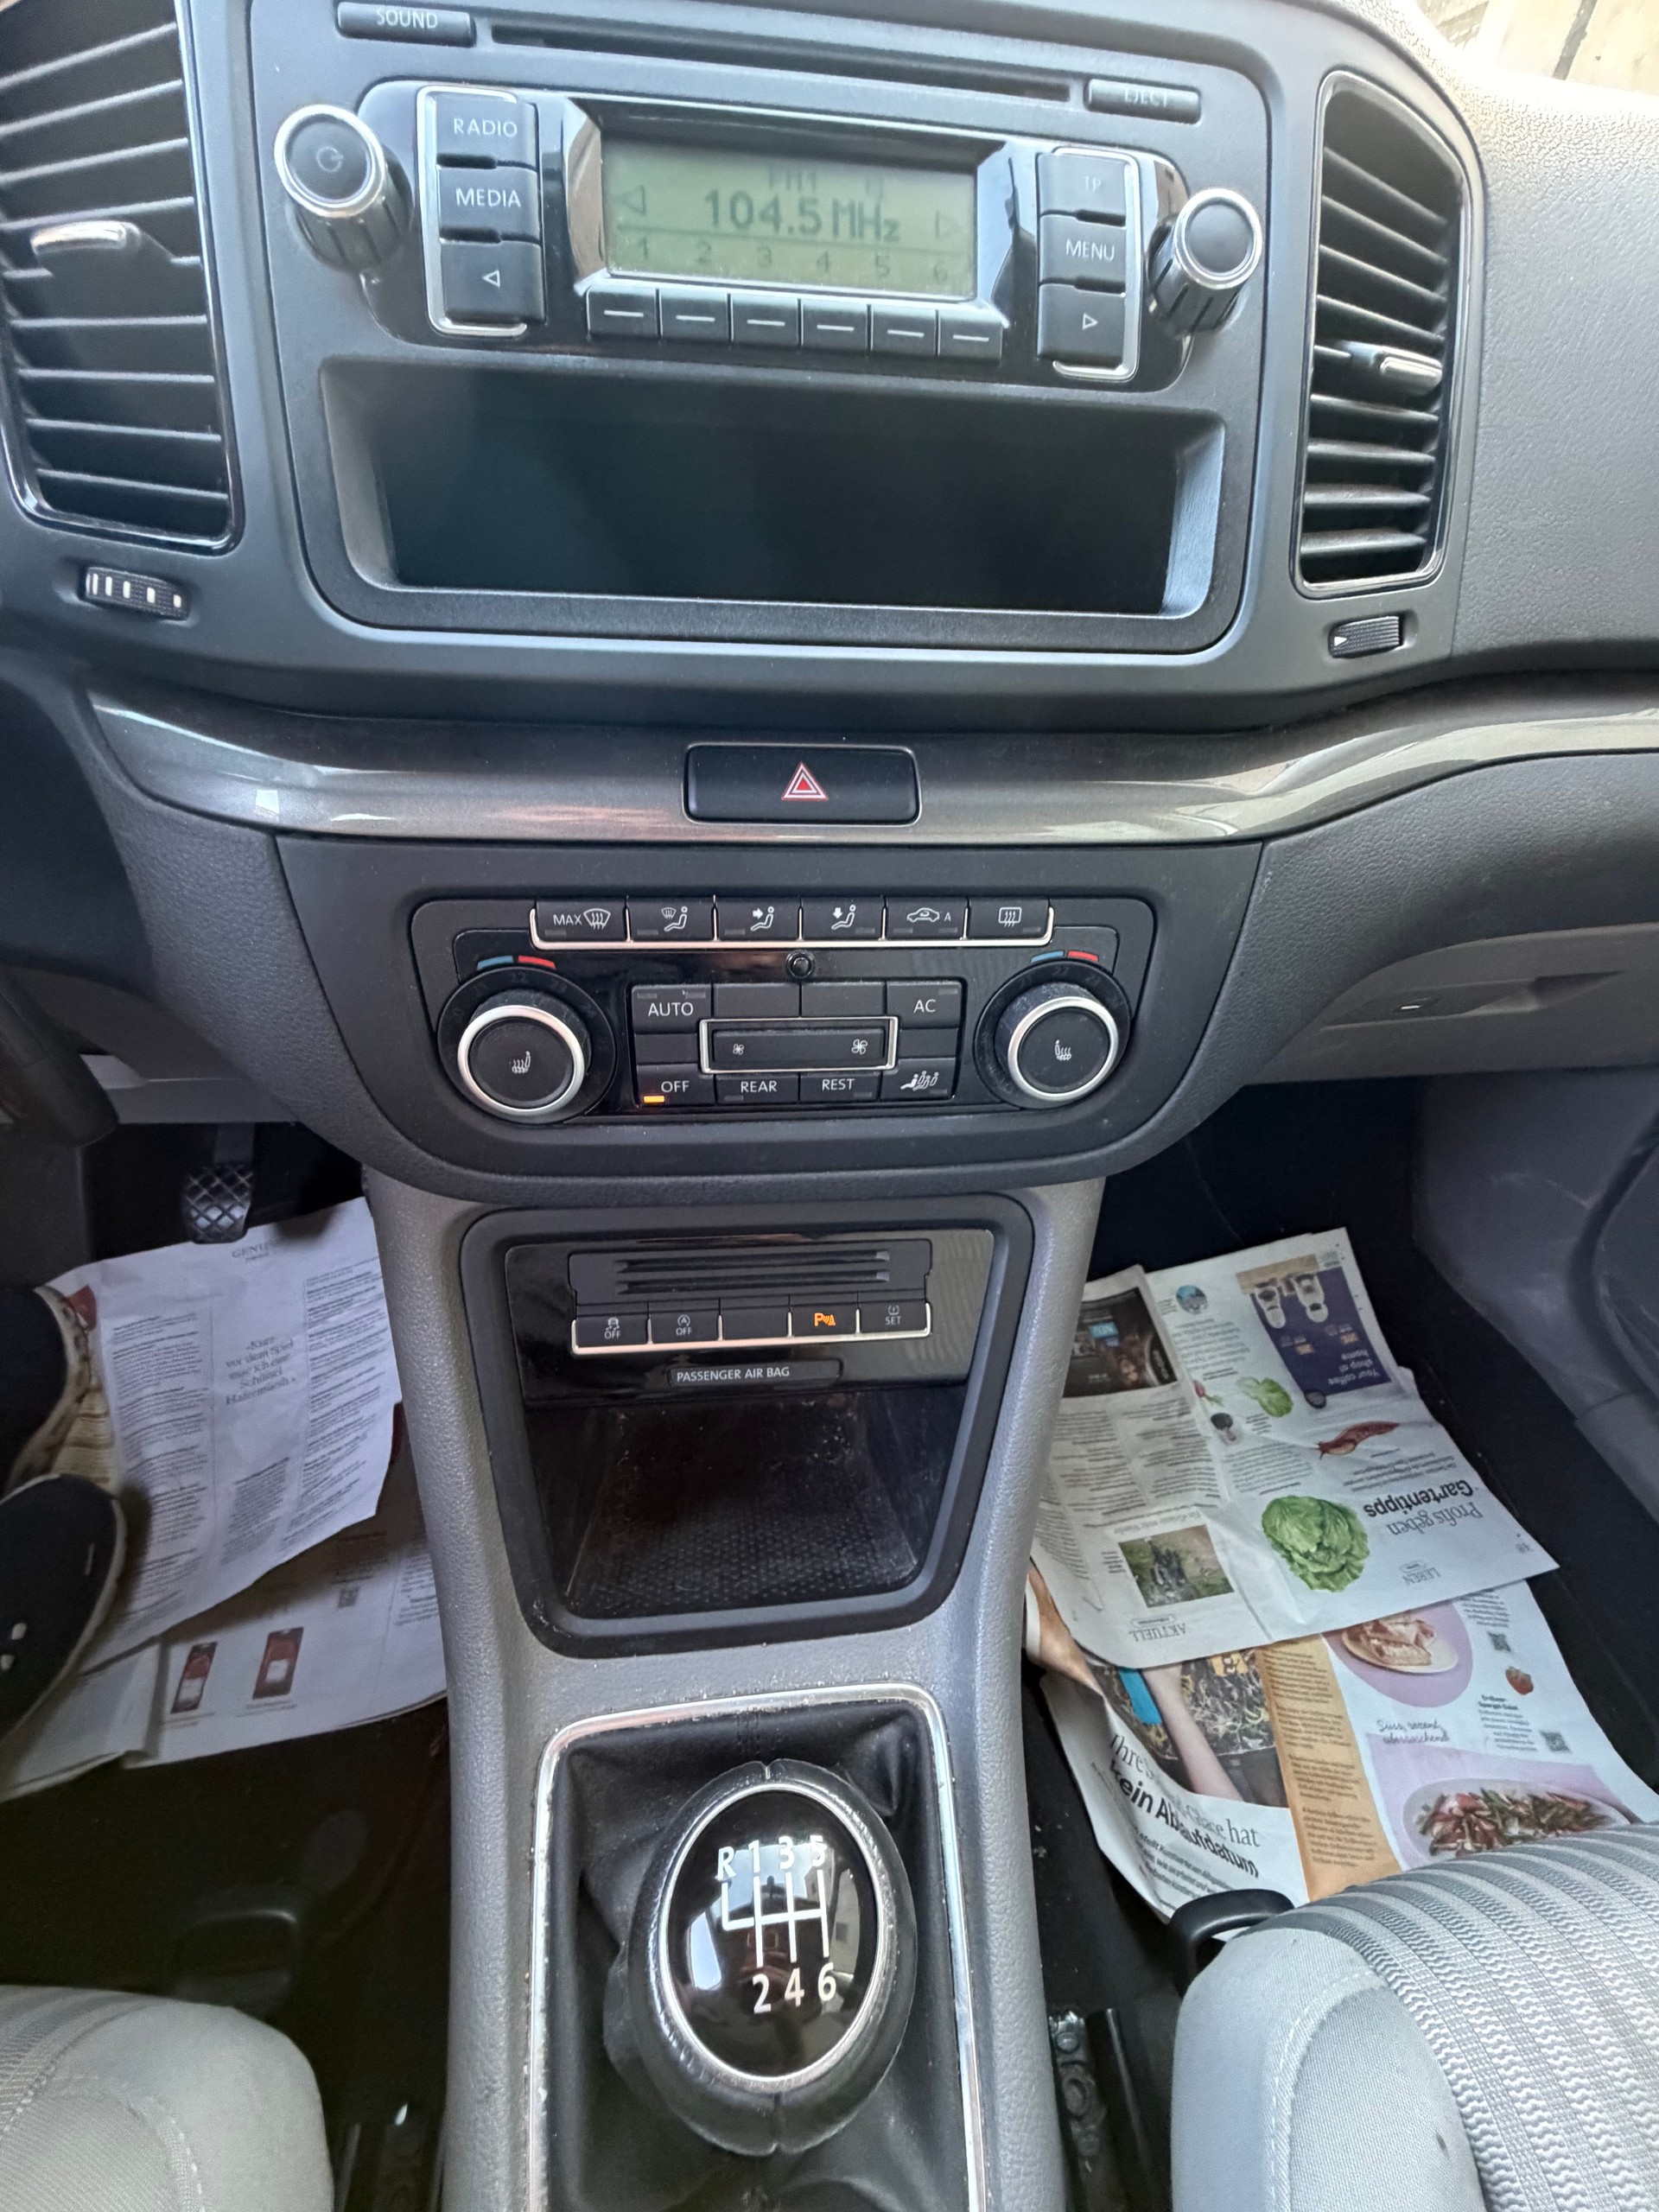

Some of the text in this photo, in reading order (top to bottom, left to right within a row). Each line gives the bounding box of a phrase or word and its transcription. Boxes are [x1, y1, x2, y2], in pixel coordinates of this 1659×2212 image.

[375, 8, 438, 30] SOUND
[453, 117, 518, 138] RADIO
[454, 187, 522, 209] MEDIA
[704, 188, 901, 244] 104.5 MHz
[637, 235, 949, 283] 1 2 3 4 5 6
[1065, 238, 1116, 261] MENU
[552, 912, 582, 926] MAX
[647, 1001, 694, 1018] AUTO
[912, 998, 937, 1014] AC
[660, 1080, 690, 1094] OFF
[740, 1080, 778, 1094] REAR
[821, 1077, 855, 1091] REST
[675, 1325, 693, 1337] OFF
[885, 1315, 902, 1326] SET
[604, 1329, 622, 1340] OFF
[676, 1365, 791, 1382] PASSENGER AIR BAG
[1363, 1478, 1474, 1518] Gartentipps
[1386, 1501, 1484, 1535] Profis geben
[1154, 1796, 1260, 1879] Abaufdatum
[1226, 1818, 1262, 1847] hat
[717, 1834, 828, 1882] R 1 3 5
[752, 1961, 837, 2015] 2 4 6
